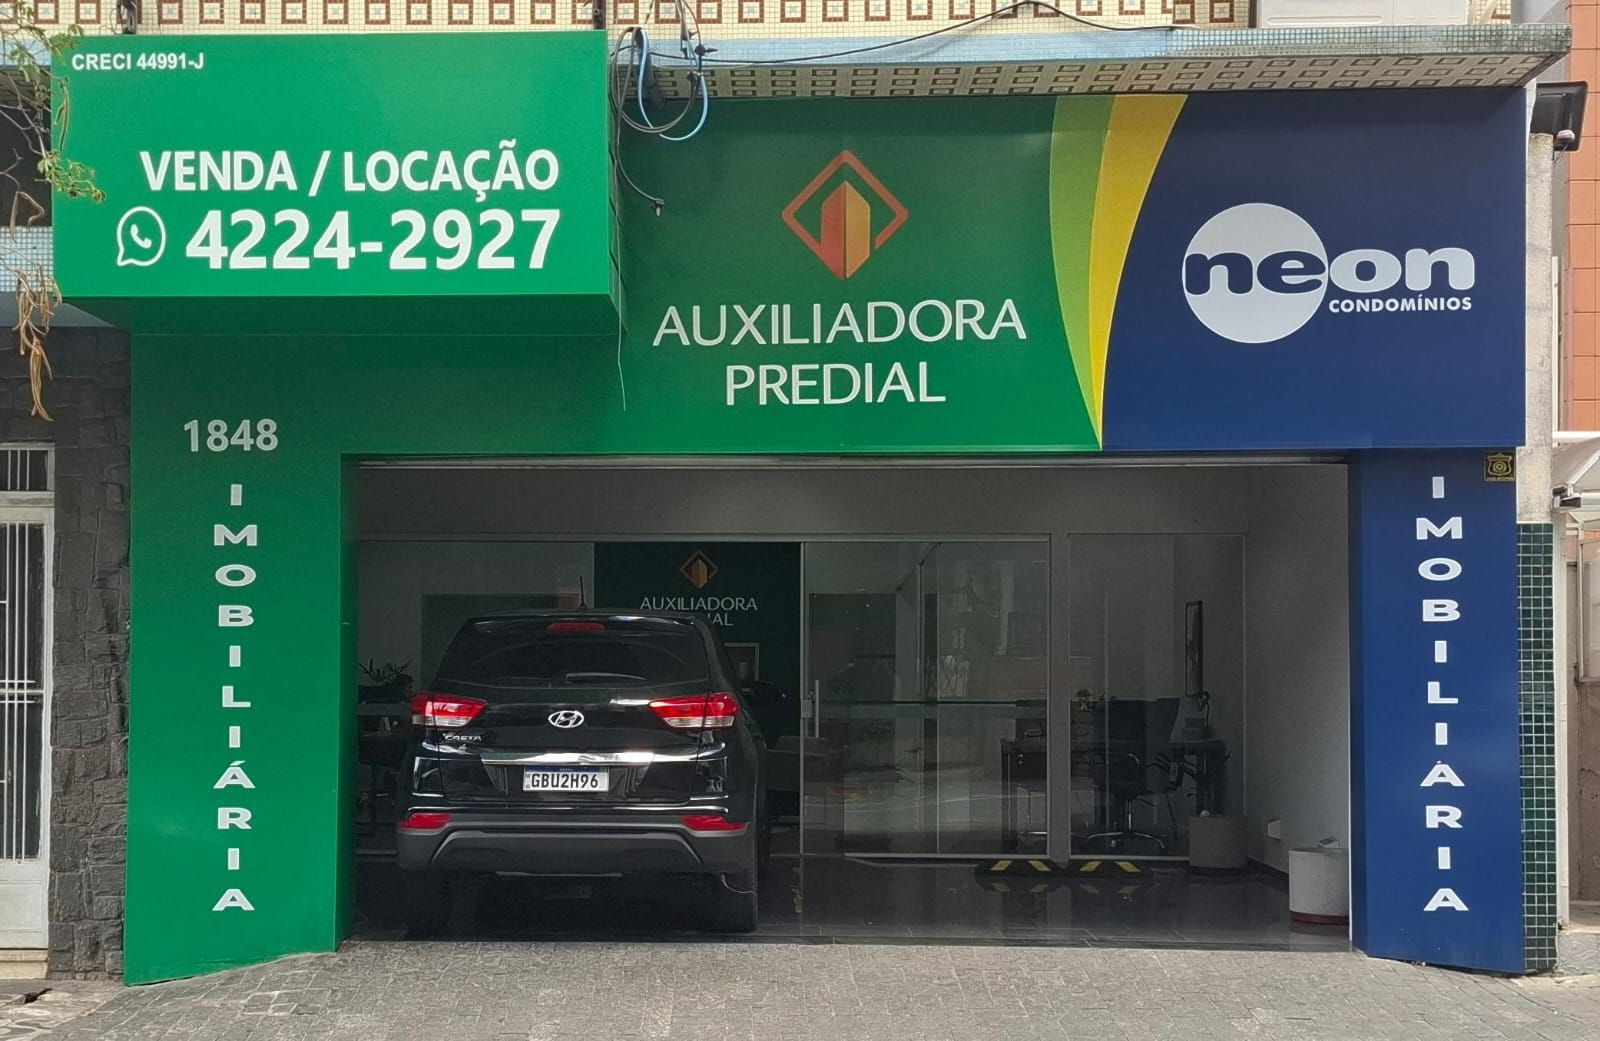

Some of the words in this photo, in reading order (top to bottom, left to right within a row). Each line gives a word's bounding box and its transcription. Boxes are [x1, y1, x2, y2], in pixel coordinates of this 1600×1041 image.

[71, 52, 132, 70] CRECI
[136, 52, 204, 70] 44991-J
[139, 150, 298, 191] VENDA
[308, 150, 331, 197] /
[343, 138, 560, 203] LOCAÇÃO
[185, 208, 561, 270] 4224-2927
[1185, 246, 1476, 296] neon
[652, 298, 1027, 348] AUXILIADORA
[1328, 295, 1473, 313] CONDOMÍNIOS
[726, 361, 946, 406] PREDIAL
[184, 418, 279, 452] 1848
[640, 596, 758, 611] AUXILIADORA
[212, 483, 258, 912] IMOBILIÁRIA
[531, 773, 599, 789] GBU2H96
